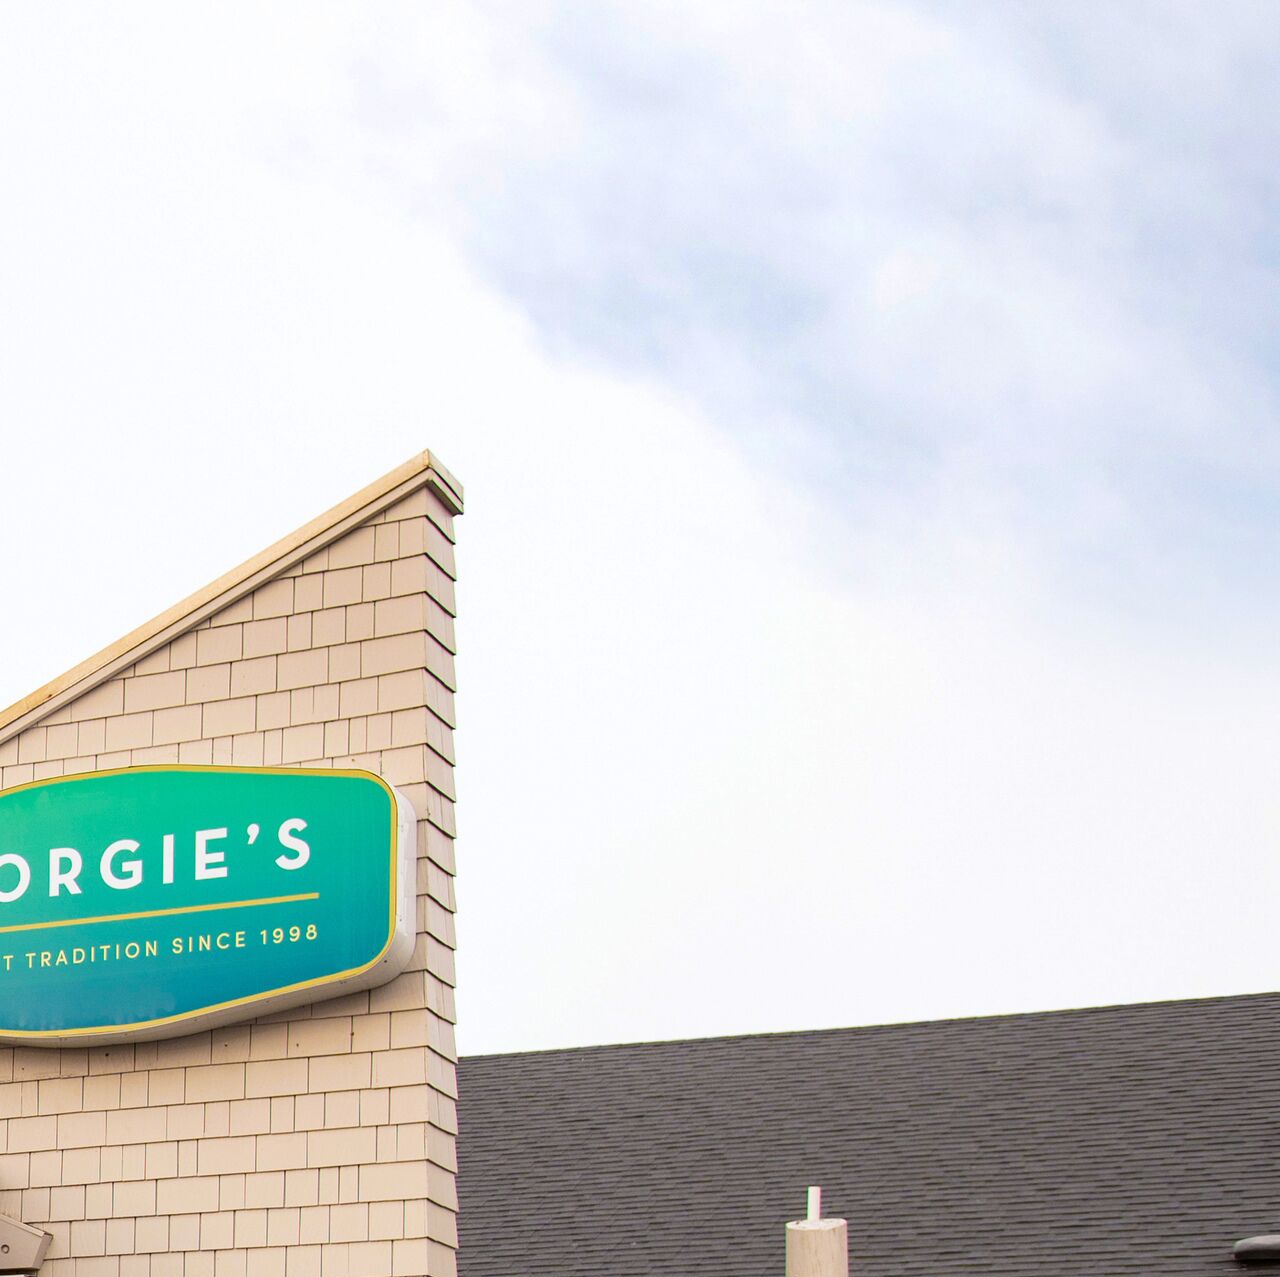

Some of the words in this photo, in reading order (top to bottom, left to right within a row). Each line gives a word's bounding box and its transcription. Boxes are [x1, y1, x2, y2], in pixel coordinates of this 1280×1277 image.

[25, 940, 157, 969] TRADITION
[172, 931, 246, 954] SINCE
[260, 924, 318, 945] 1998
